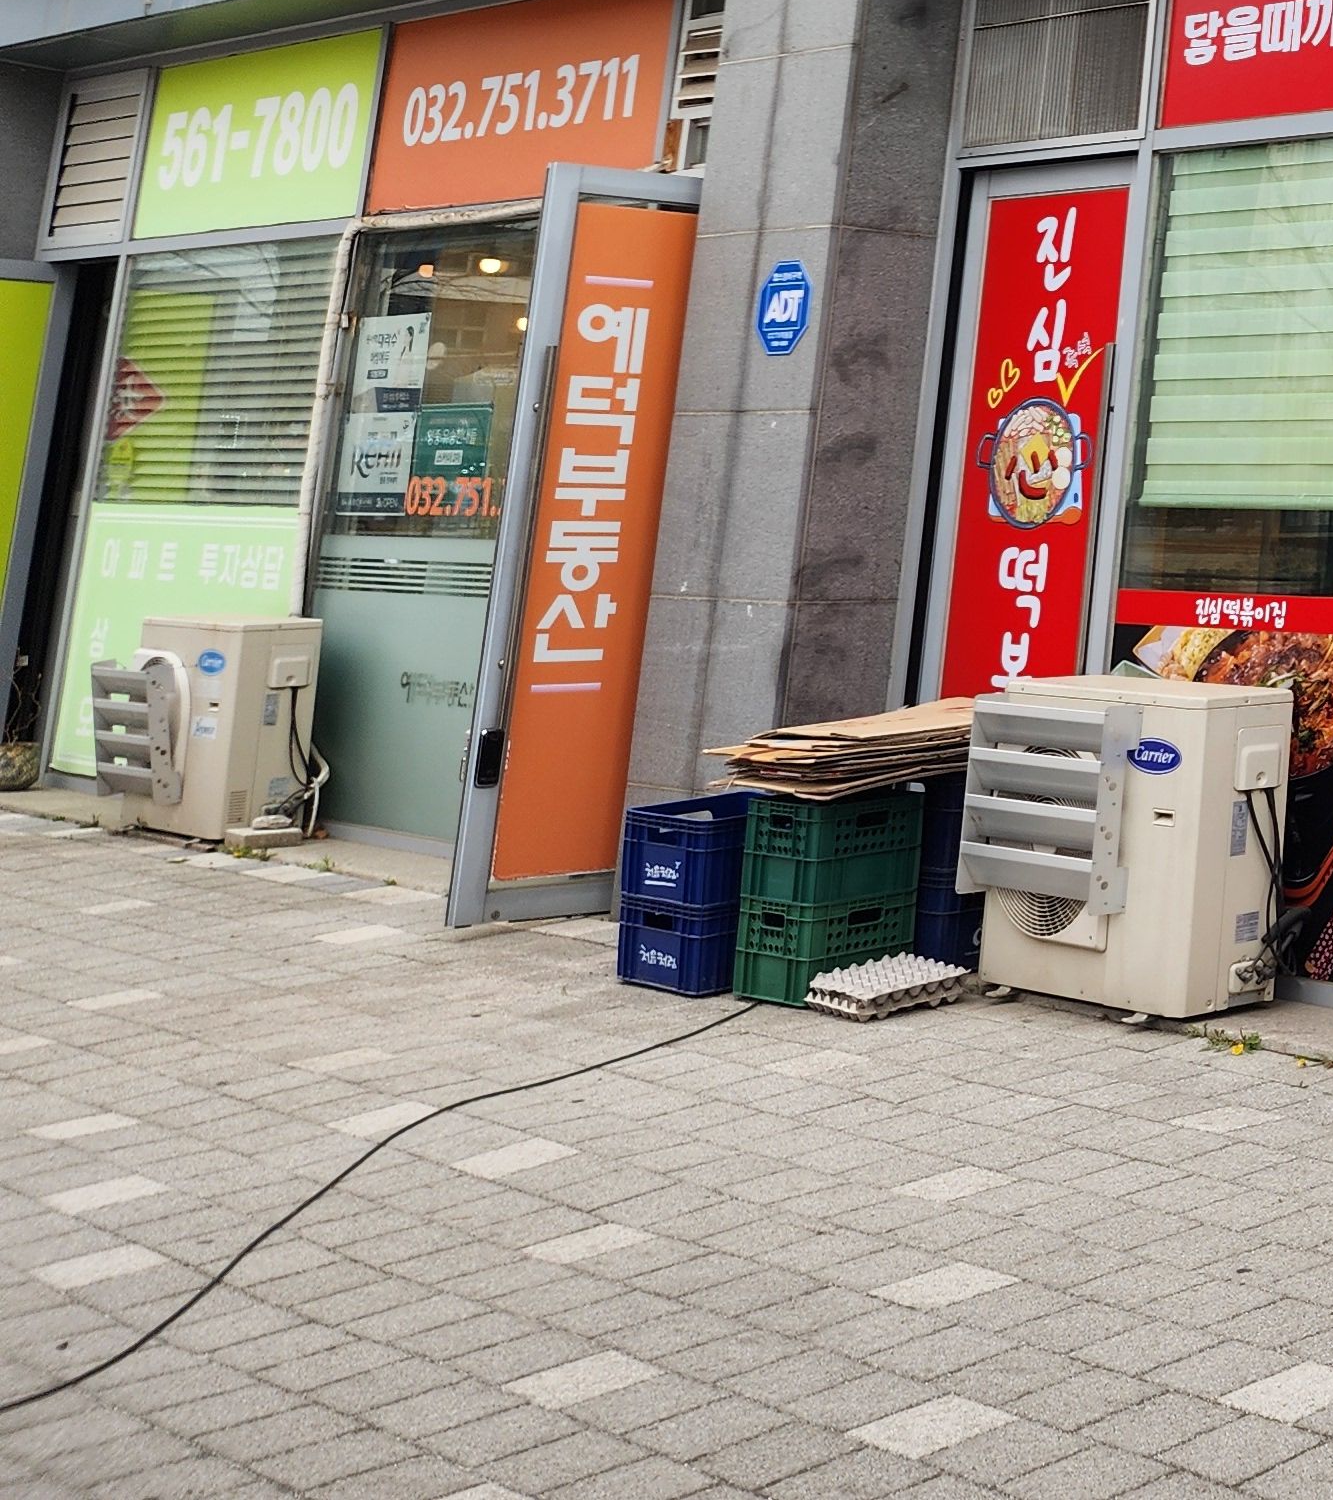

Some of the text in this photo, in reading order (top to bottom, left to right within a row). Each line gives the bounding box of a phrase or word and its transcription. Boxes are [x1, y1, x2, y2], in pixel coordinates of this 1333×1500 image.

[402, 54, 640, 149] 032.751.3711
[158, 82, 358, 191] 561-7800
[763, 290, 804, 323] ADT
[1026, 206, 1077, 383] 진심
[404, 476, 501, 517] 032.751.
[533, 302, 648, 665] 예덕부동산
[199, 541, 285, 591] 투자상담
[1195, 597, 1288, 631] 진심떡볶이집
[1133, 747, 1176, 766] Carrier
